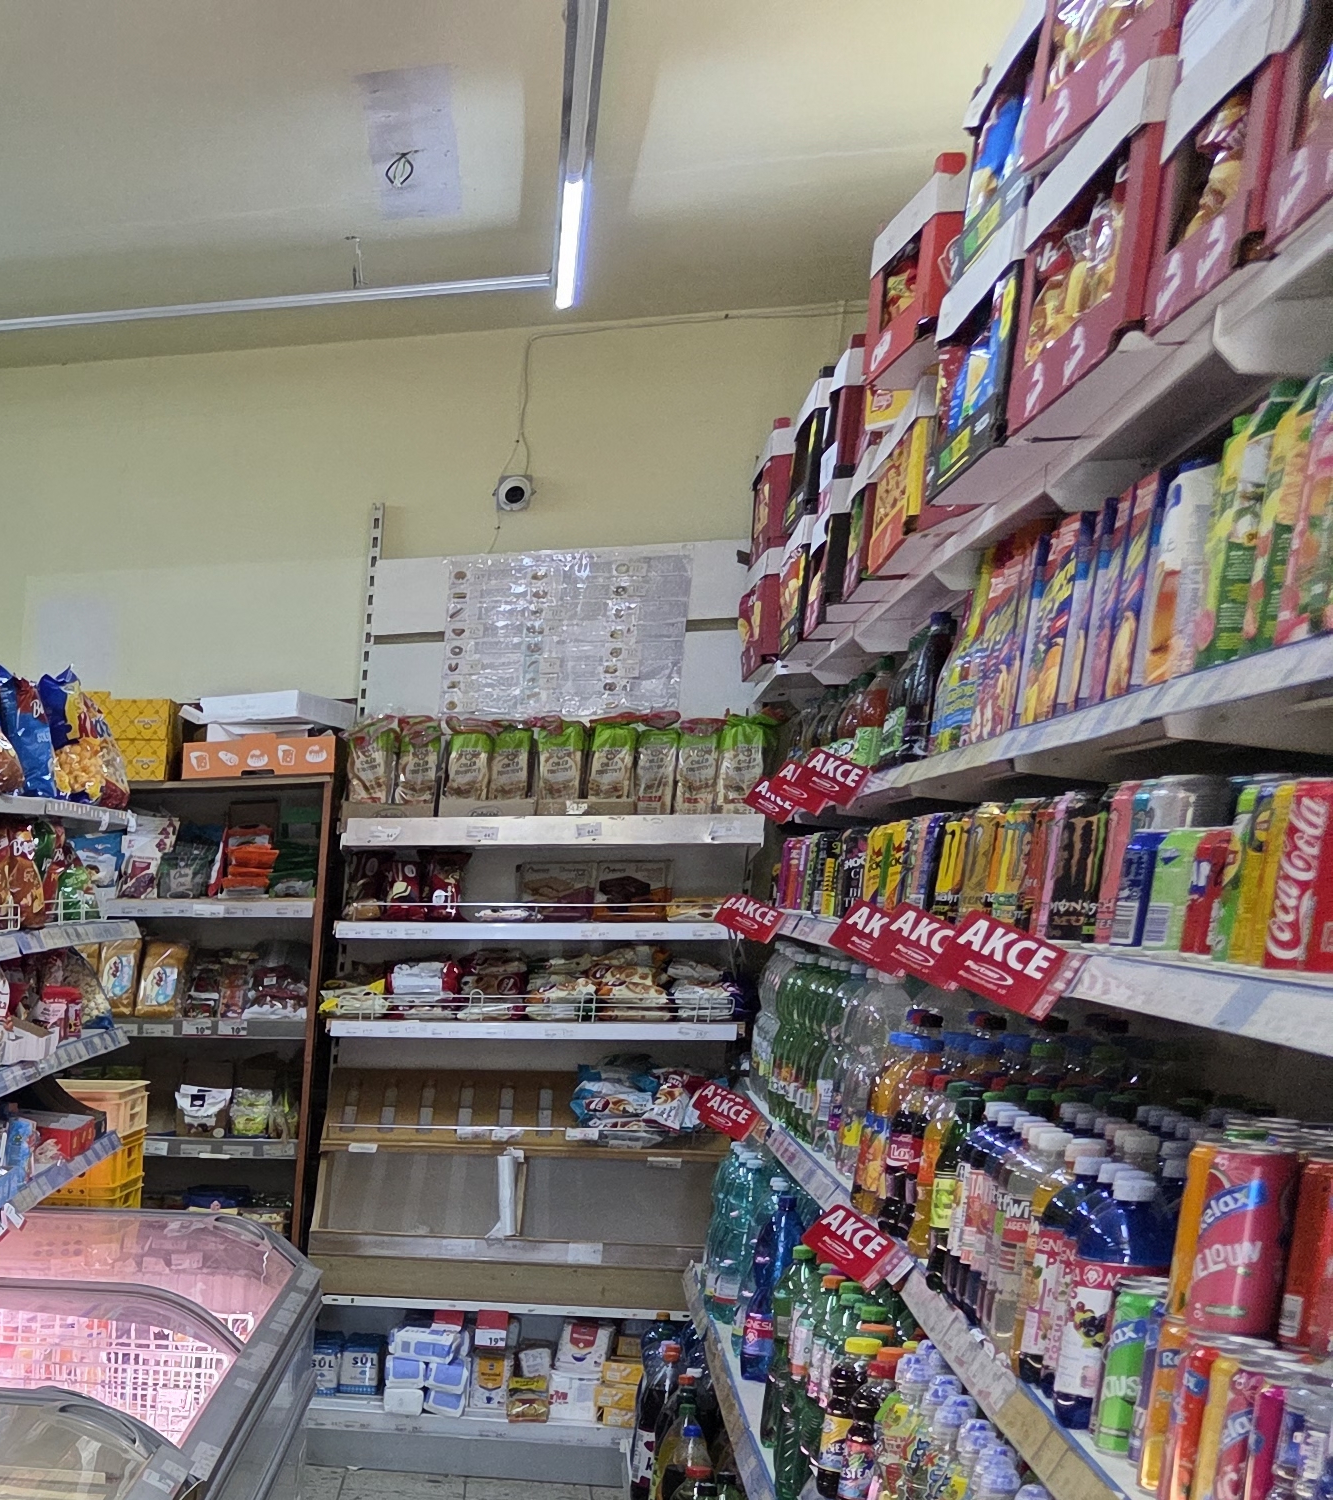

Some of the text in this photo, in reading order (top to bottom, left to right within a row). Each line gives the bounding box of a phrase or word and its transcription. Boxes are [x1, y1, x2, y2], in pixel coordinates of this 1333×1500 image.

[806, 753, 864, 788] AKCE
[732, 901, 778, 926] AKCE
[957, 918, 1059, 980] AKCE
[707, 1095, 752, 1124] AKCE
[821, 1209, 889, 1260] AKCE
